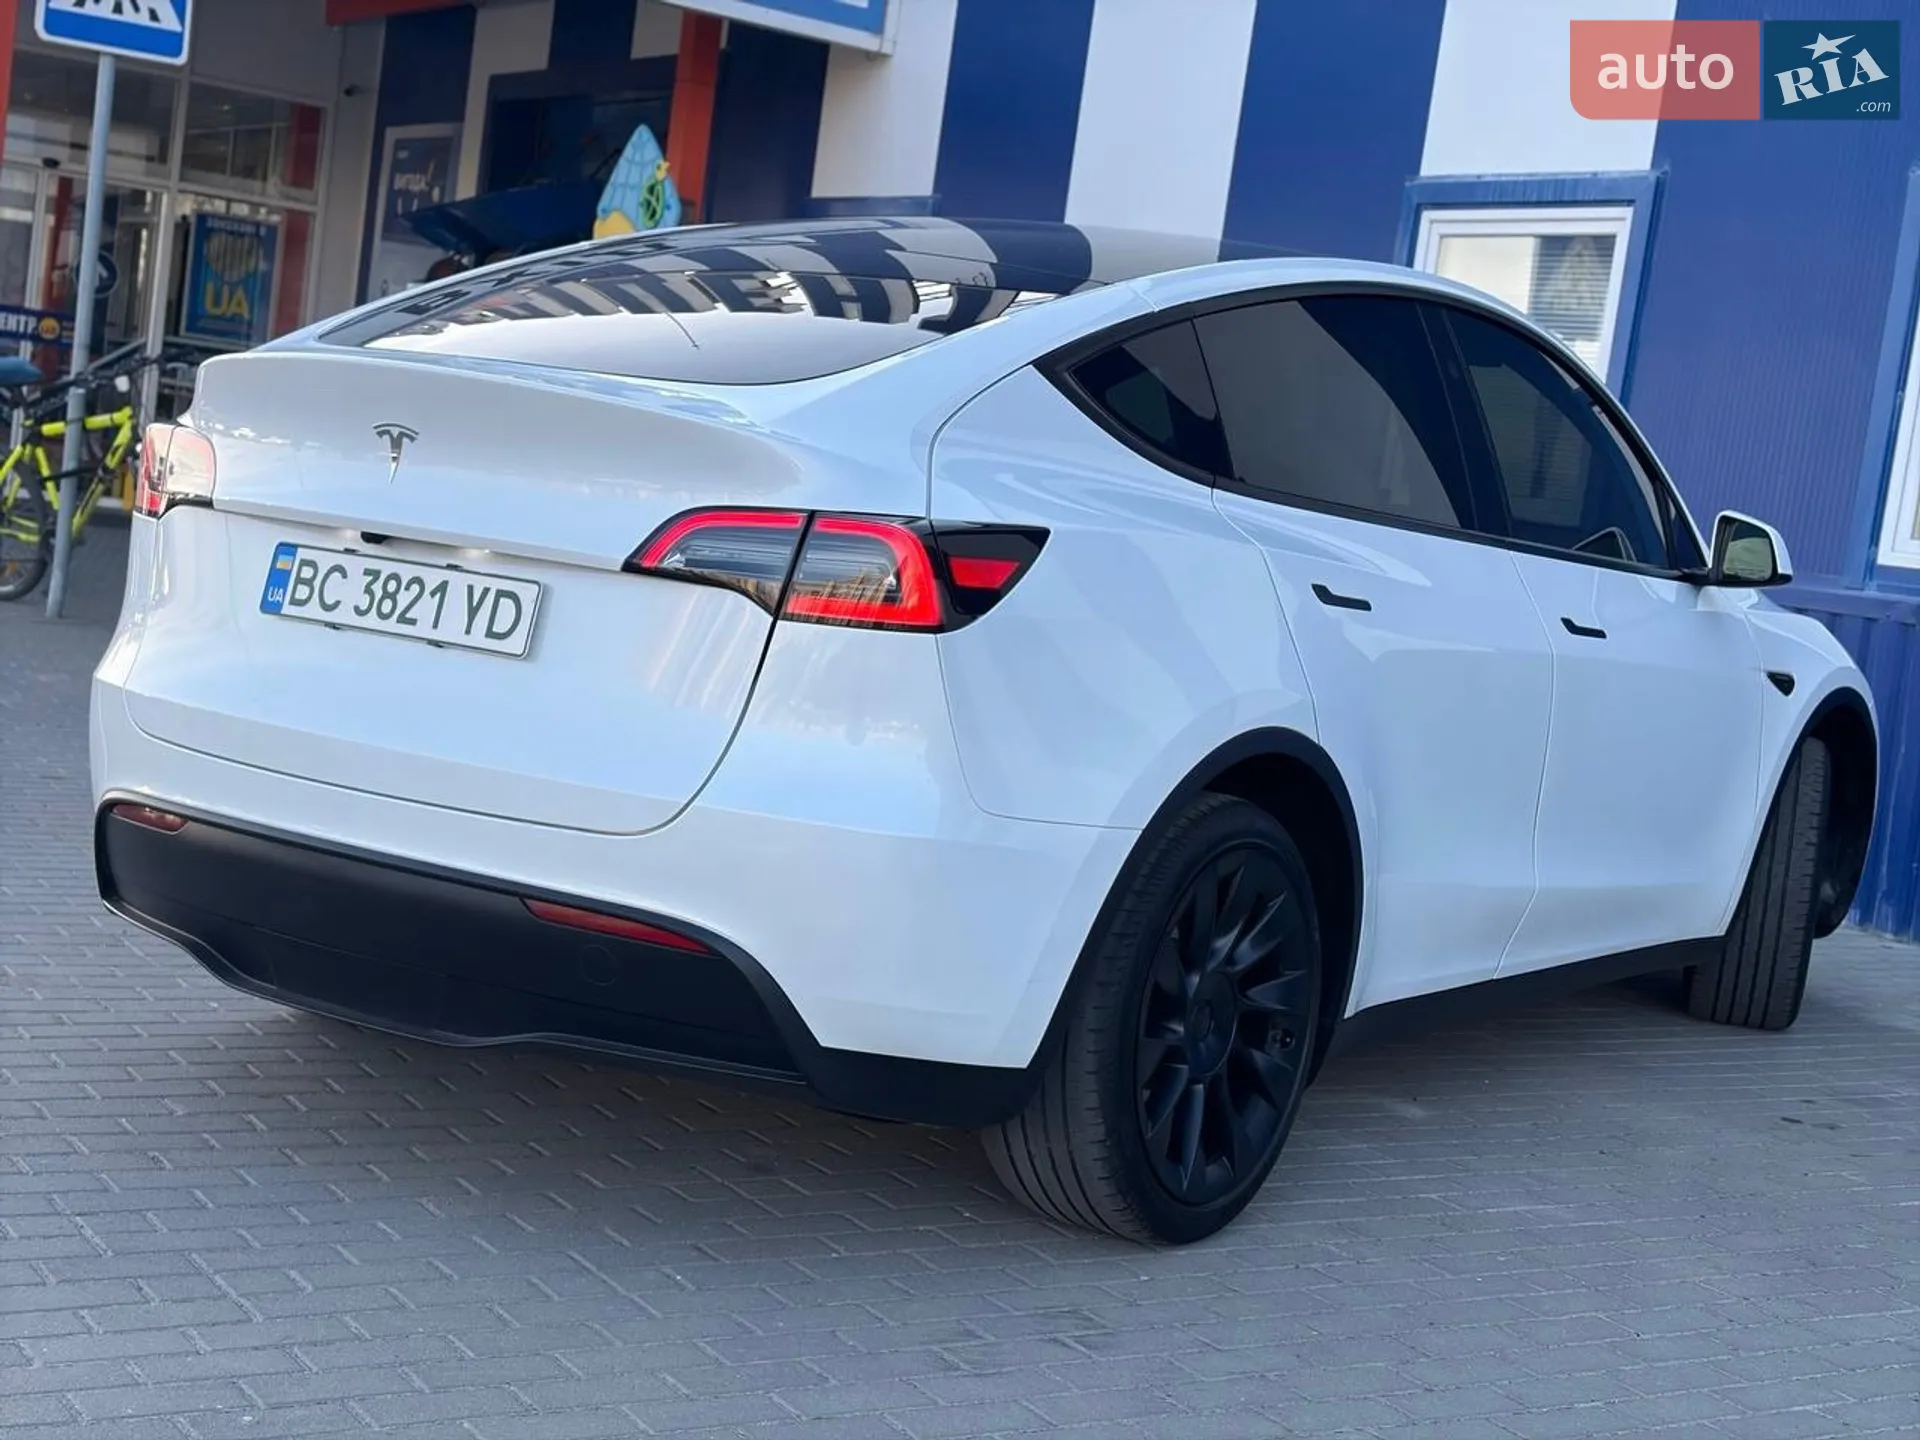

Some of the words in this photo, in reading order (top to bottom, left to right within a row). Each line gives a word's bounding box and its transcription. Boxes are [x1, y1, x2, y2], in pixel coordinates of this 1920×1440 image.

[205, 280, 250, 319] UA
[268, 586, 284, 602] UA
[288, 558, 348, 612] BC
[353, 567, 449, 630] 3821
[464, 583, 523, 641] YD
